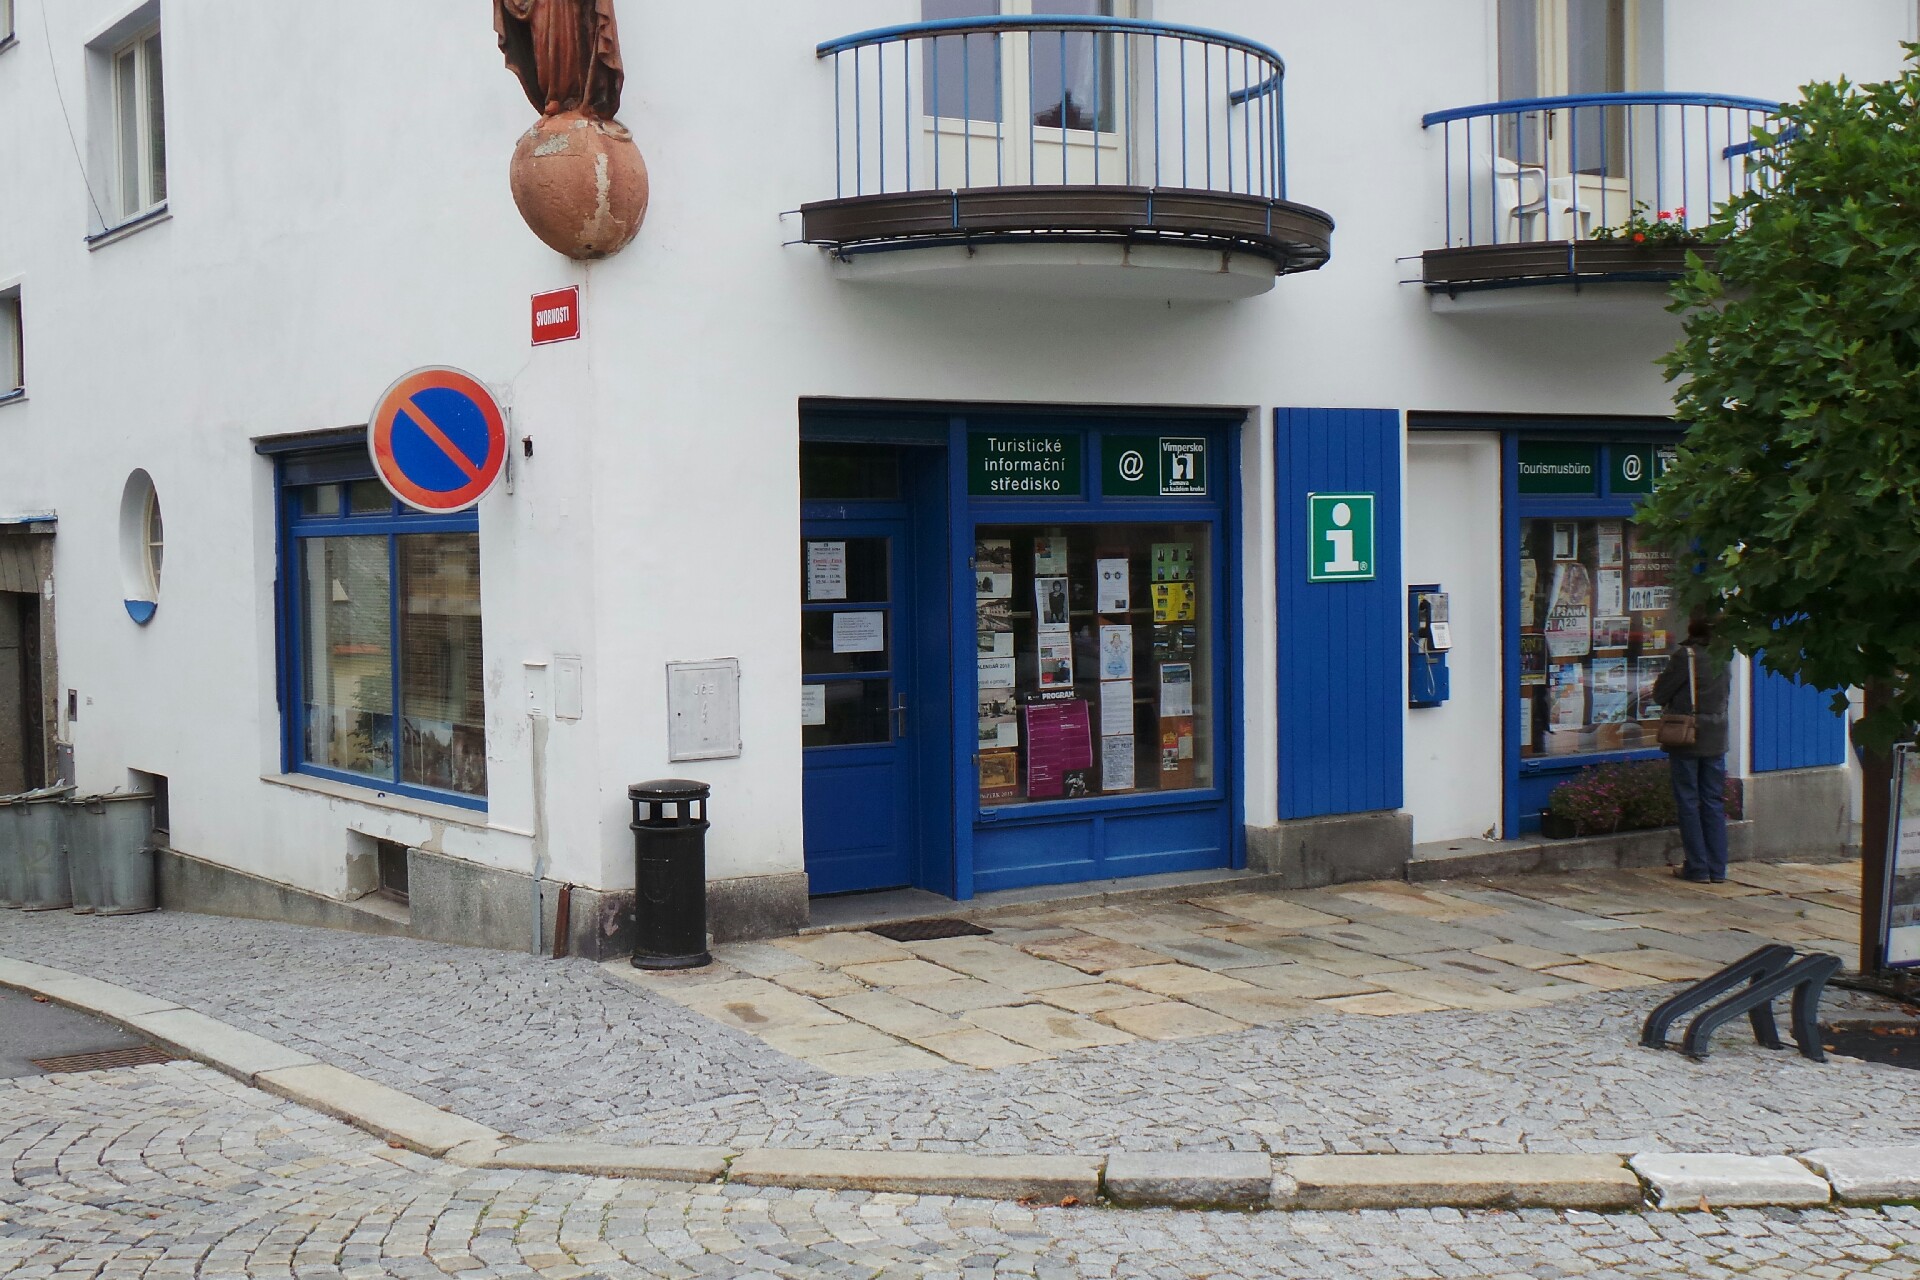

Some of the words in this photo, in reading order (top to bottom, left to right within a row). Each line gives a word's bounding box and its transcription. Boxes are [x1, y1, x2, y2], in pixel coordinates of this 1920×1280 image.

[536, 306, 570, 327] SVORNOSTI
[988, 437, 1062, 453] Turistické
[984, 457, 1066, 472] informační
[1518, 462, 1591, 475] Tourismusbüro
[990, 476, 1061, 491] středisko
[1042, 690, 1075, 700] PROGRAM
